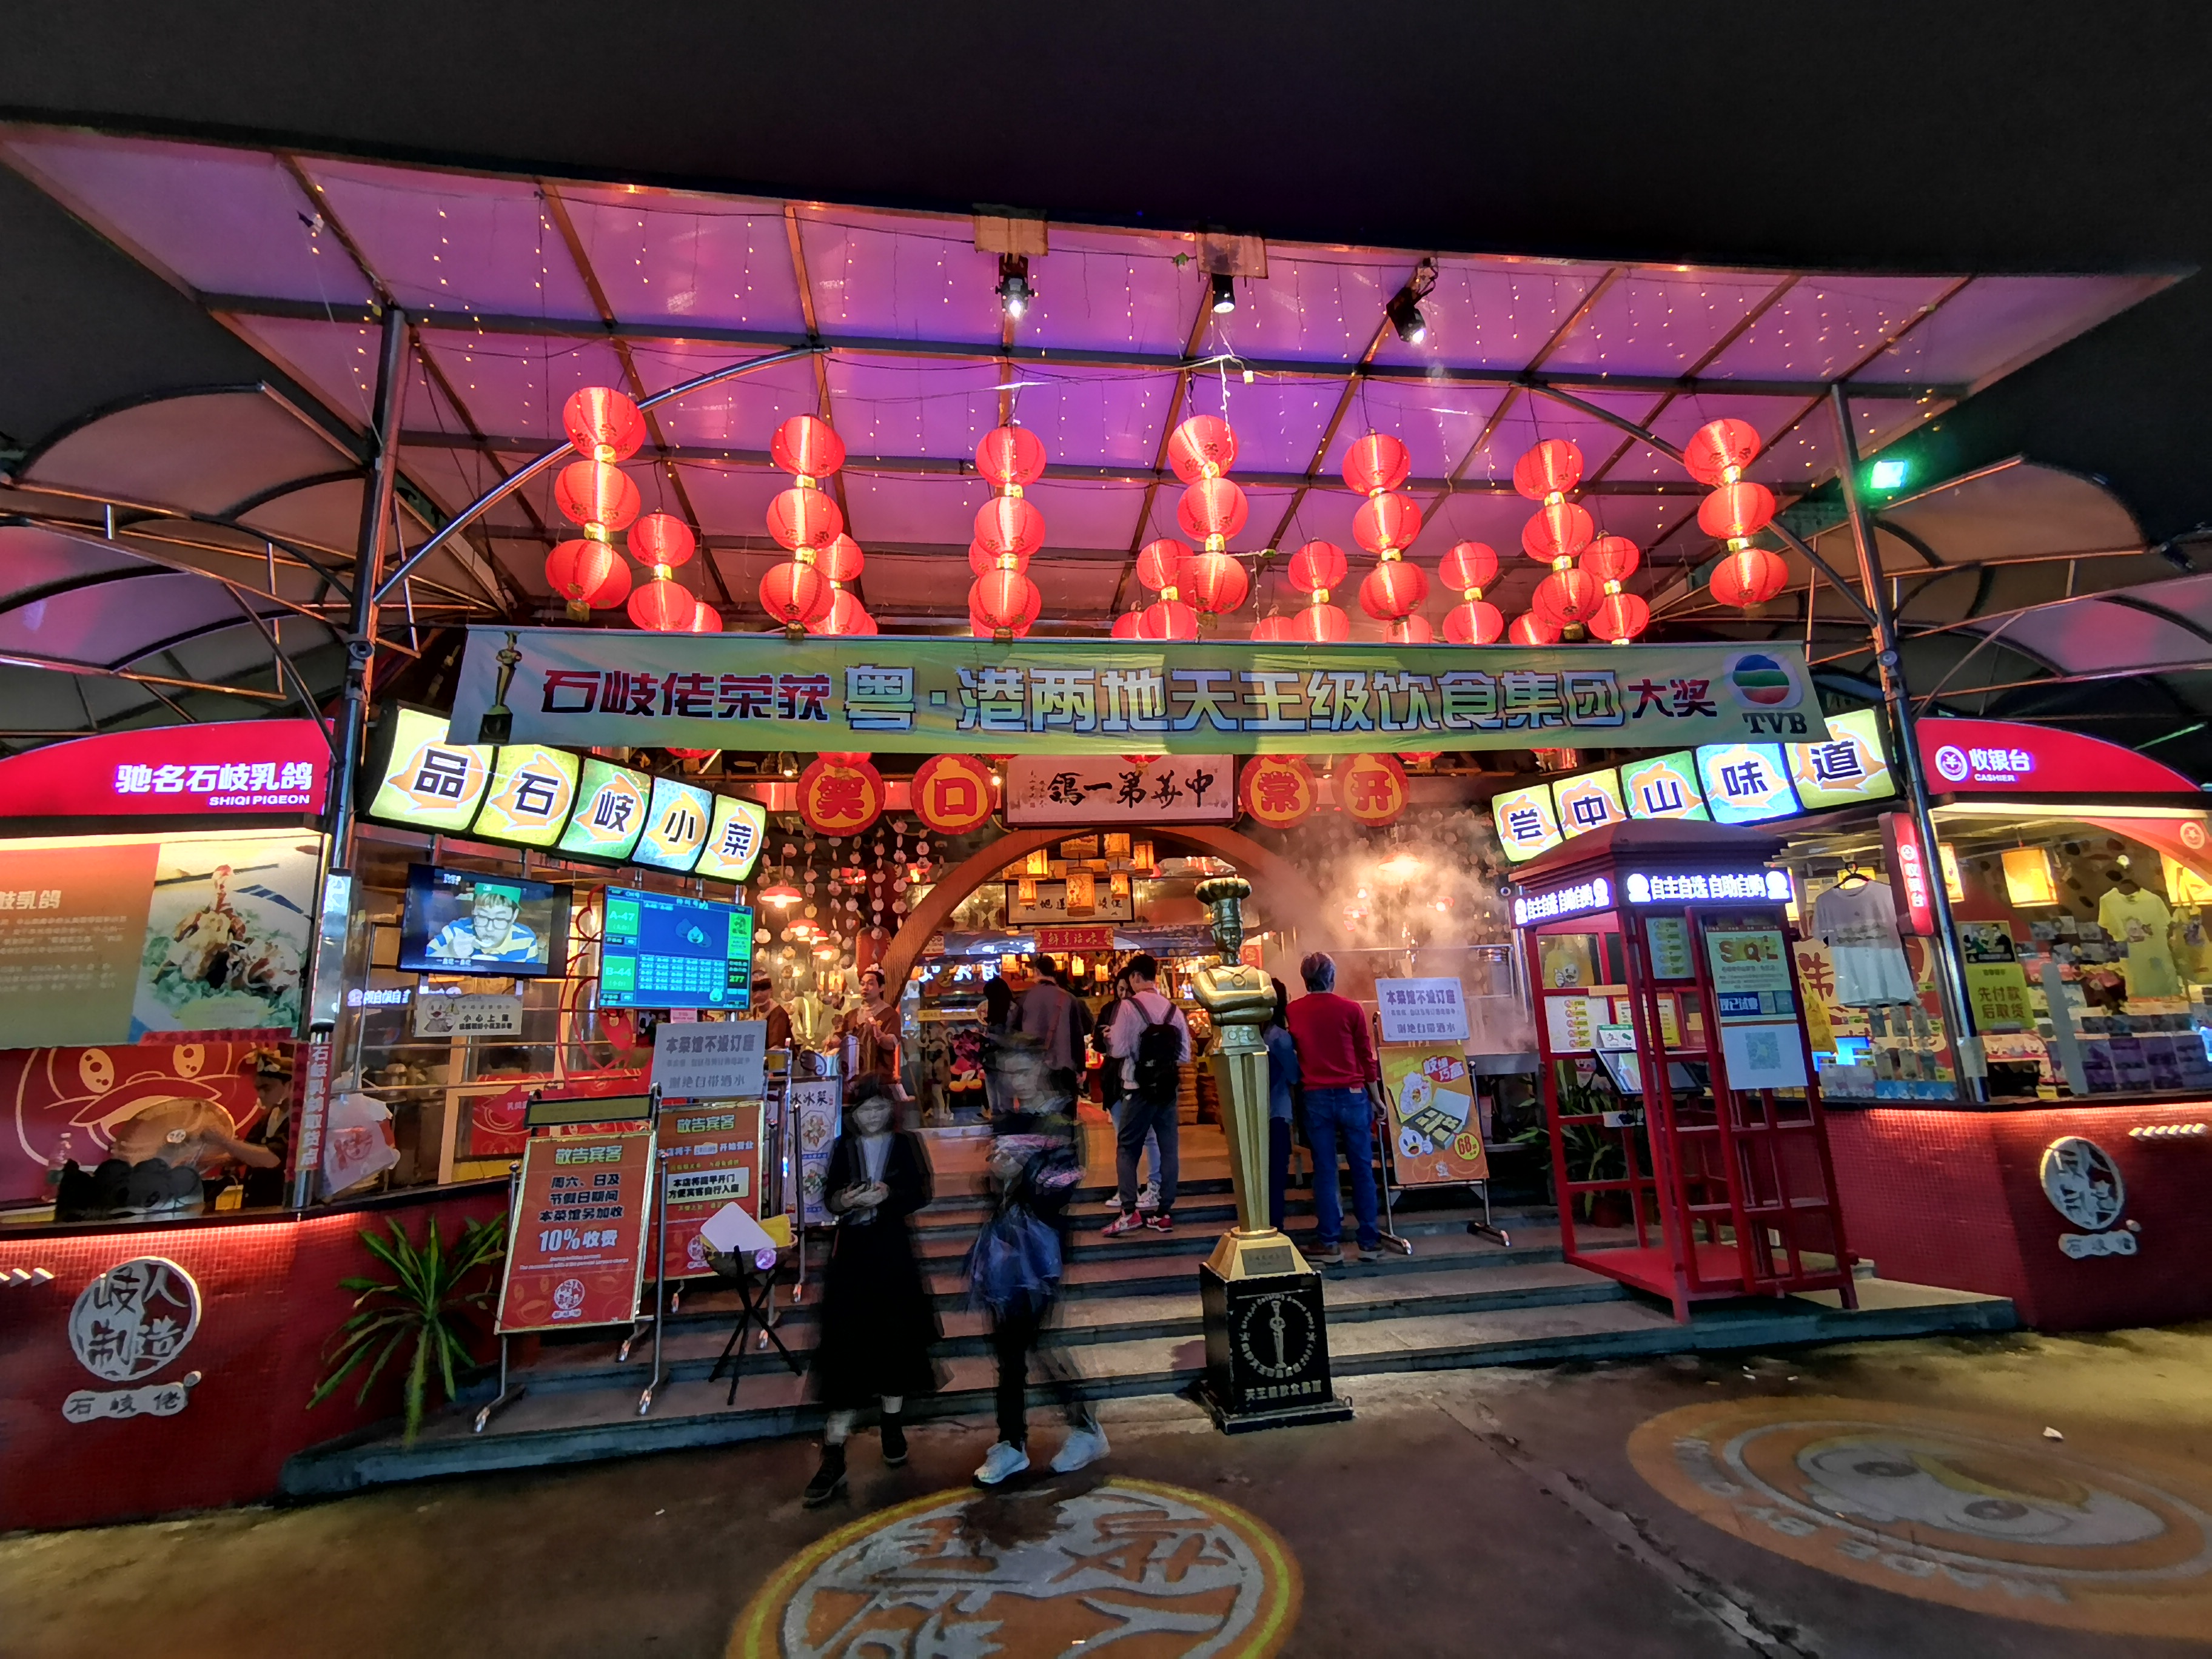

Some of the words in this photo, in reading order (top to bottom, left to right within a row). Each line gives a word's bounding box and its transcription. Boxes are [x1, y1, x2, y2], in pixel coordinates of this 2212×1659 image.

[1742, 712, 1808, 735] TVB
[1968, 748, 2031, 772] 收银台
[116, 762, 313, 793] 驰名石岐乳鸽
[1974, 773, 2016, 782] CASHIER
[1509, 739, 1863, 840] 尝中山味道
[209, 795, 250, 806] SHIQI
[252, 794, 310, 805] PIGEON
[412, 746, 752, 859] 品石岐小菜
[1905, 862, 1925, 907] 收银台
[609, 910, 635, 923] A-47
[605, 967, 632, 977] B-44
[729, 975, 745, 984] 277
[1977, 986, 2023, 1002] 先付款
[1982, 1003, 2026, 1019] 后取货
[677, 1114, 735, 1133] 敬告宾客
[1457, 1135, 1472, 1155] 68
[555, 1145, 623, 1165] 敬告宾客
[550, 1190, 619, 1205] 节假日期间
[539, 1206, 623, 1222] 本菜馆另加收
[67, 1391, 182, 1414] 石岐佬
